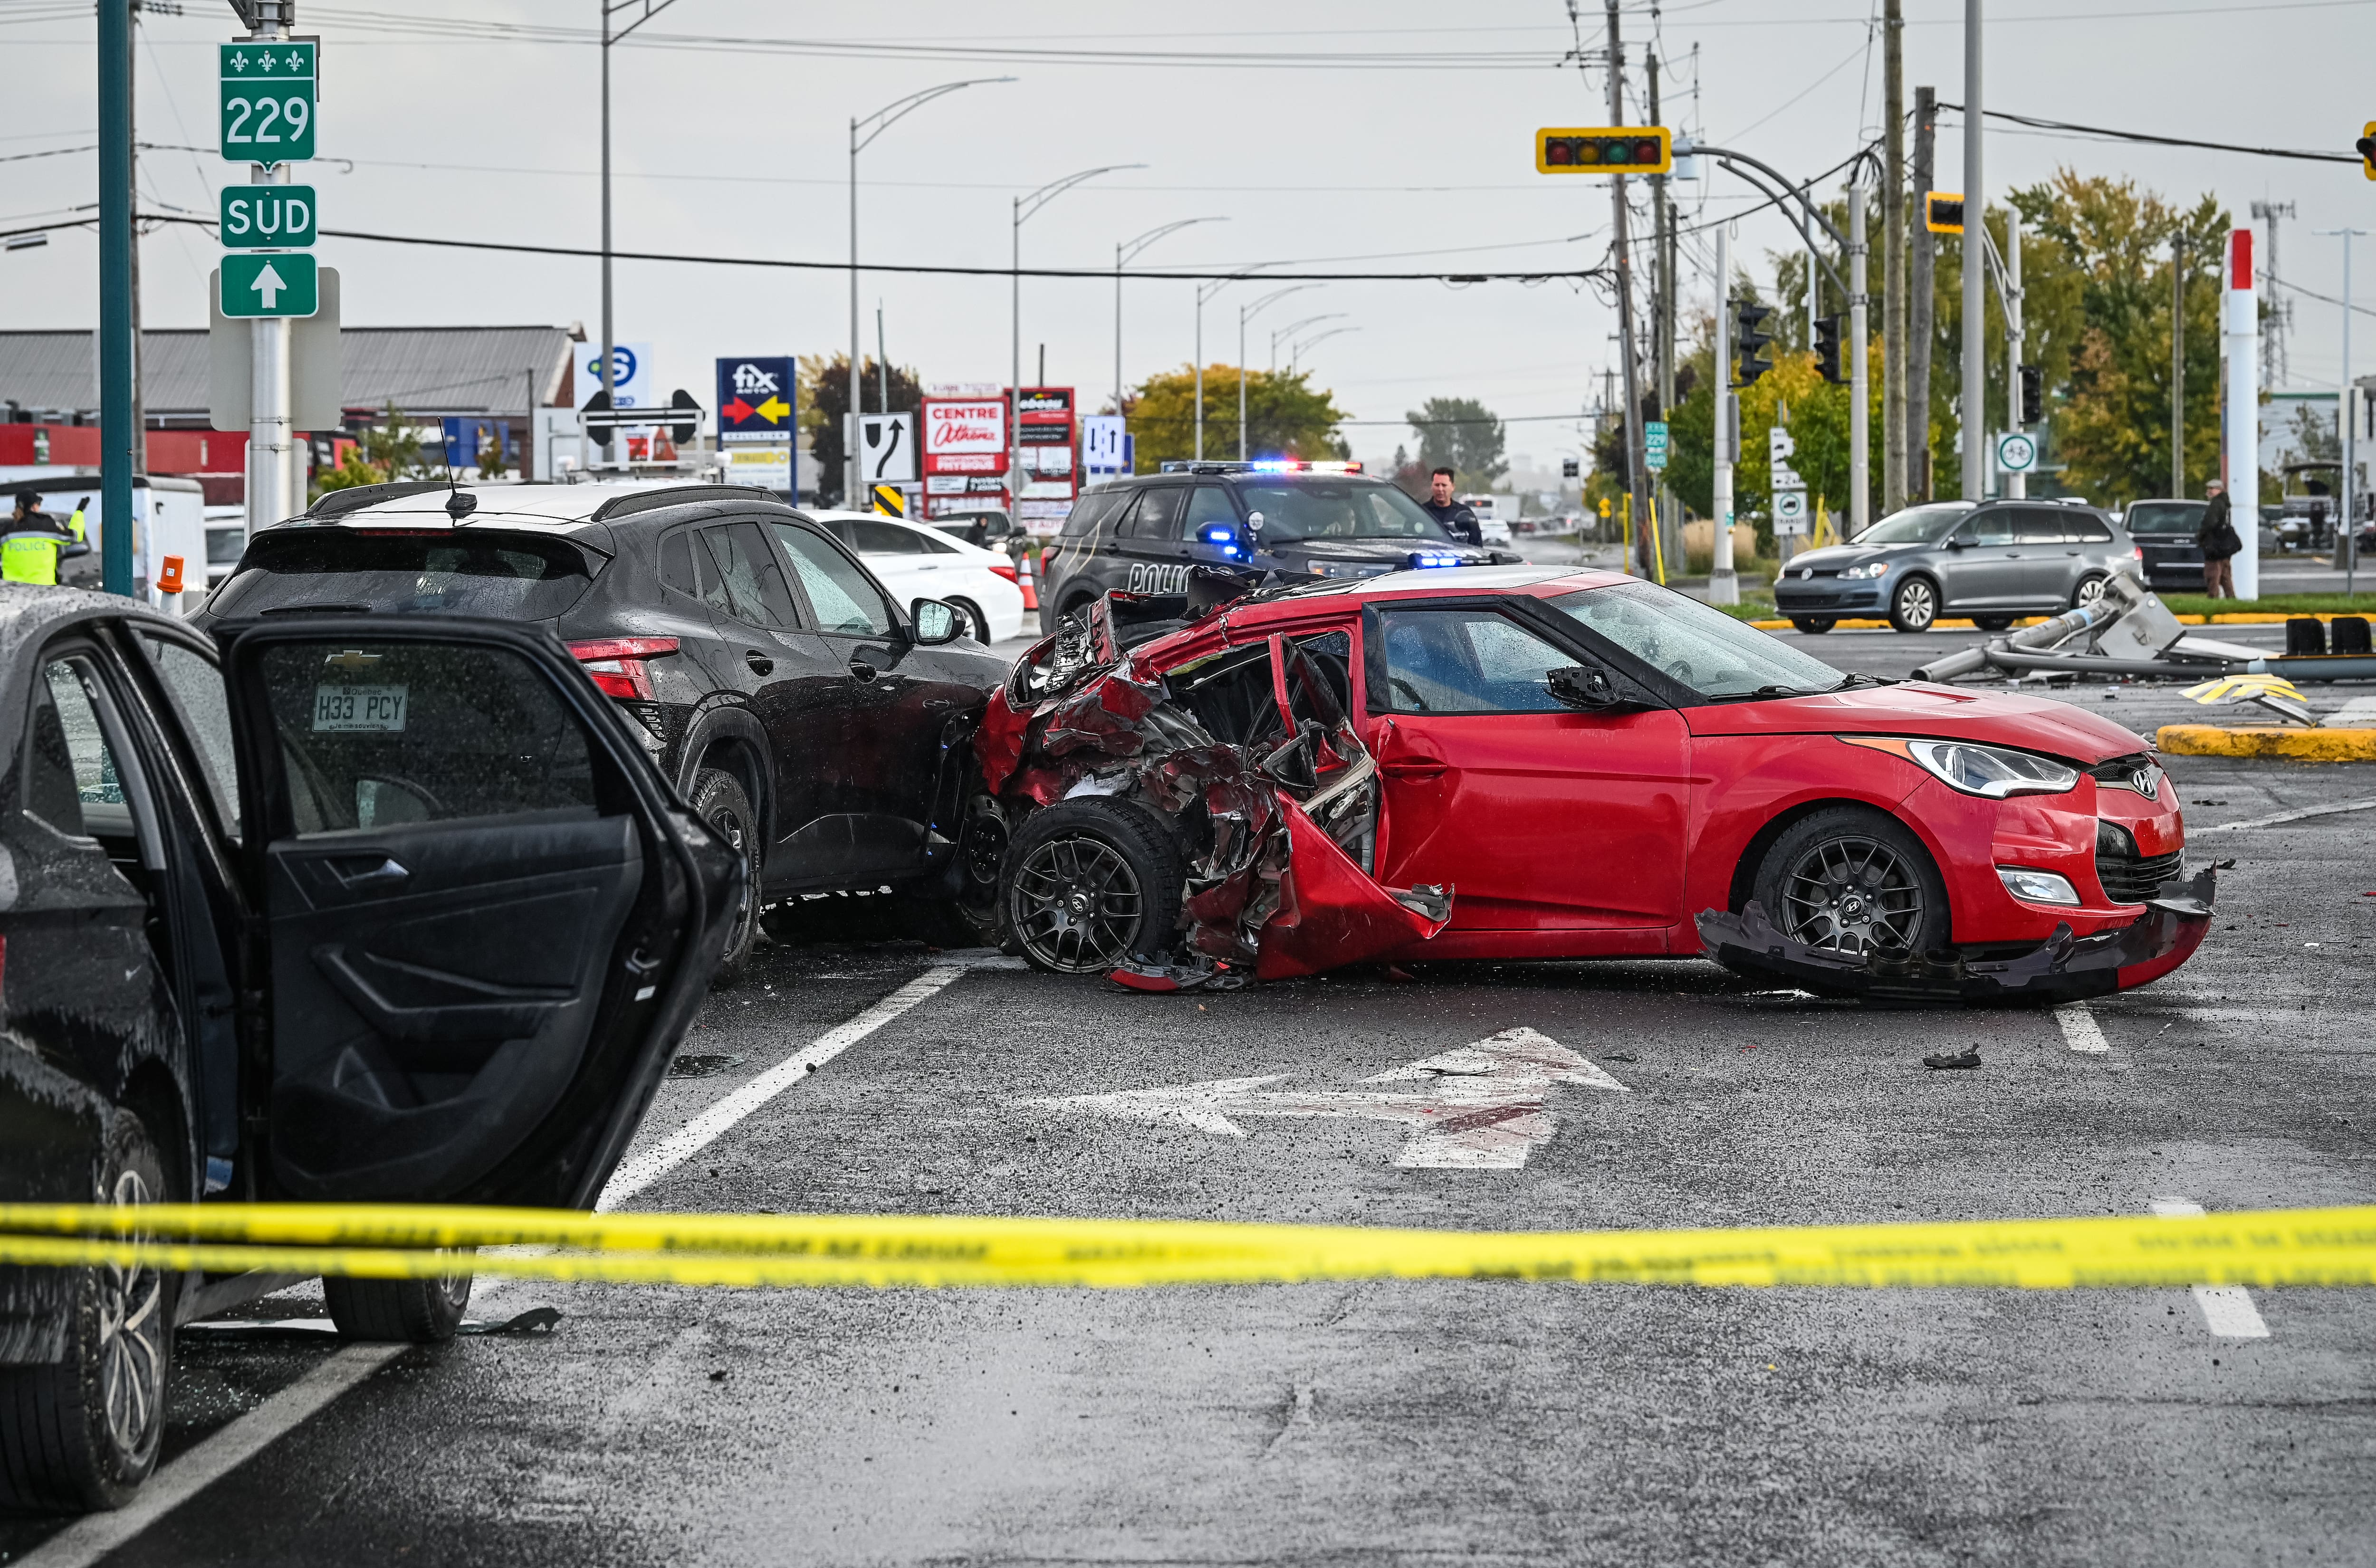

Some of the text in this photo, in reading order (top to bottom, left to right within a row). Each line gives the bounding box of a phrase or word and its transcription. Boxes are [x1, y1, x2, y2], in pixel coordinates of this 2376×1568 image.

[227, 97, 309, 143] 229
[227, 199, 309, 234] SUD
[732, 363, 780, 392] fix
[1018, 397, 1063, 410] ebeau
[933, 408, 997, 419] CENTRE
[1647, 434, 1666, 446] 229
[1785, 475, 1791, 485] 2
[9, 541, 47, 551] POLICE
[1127, 563, 1192, 593] POLIC
[318, 696, 403, 720] H33 PCY
